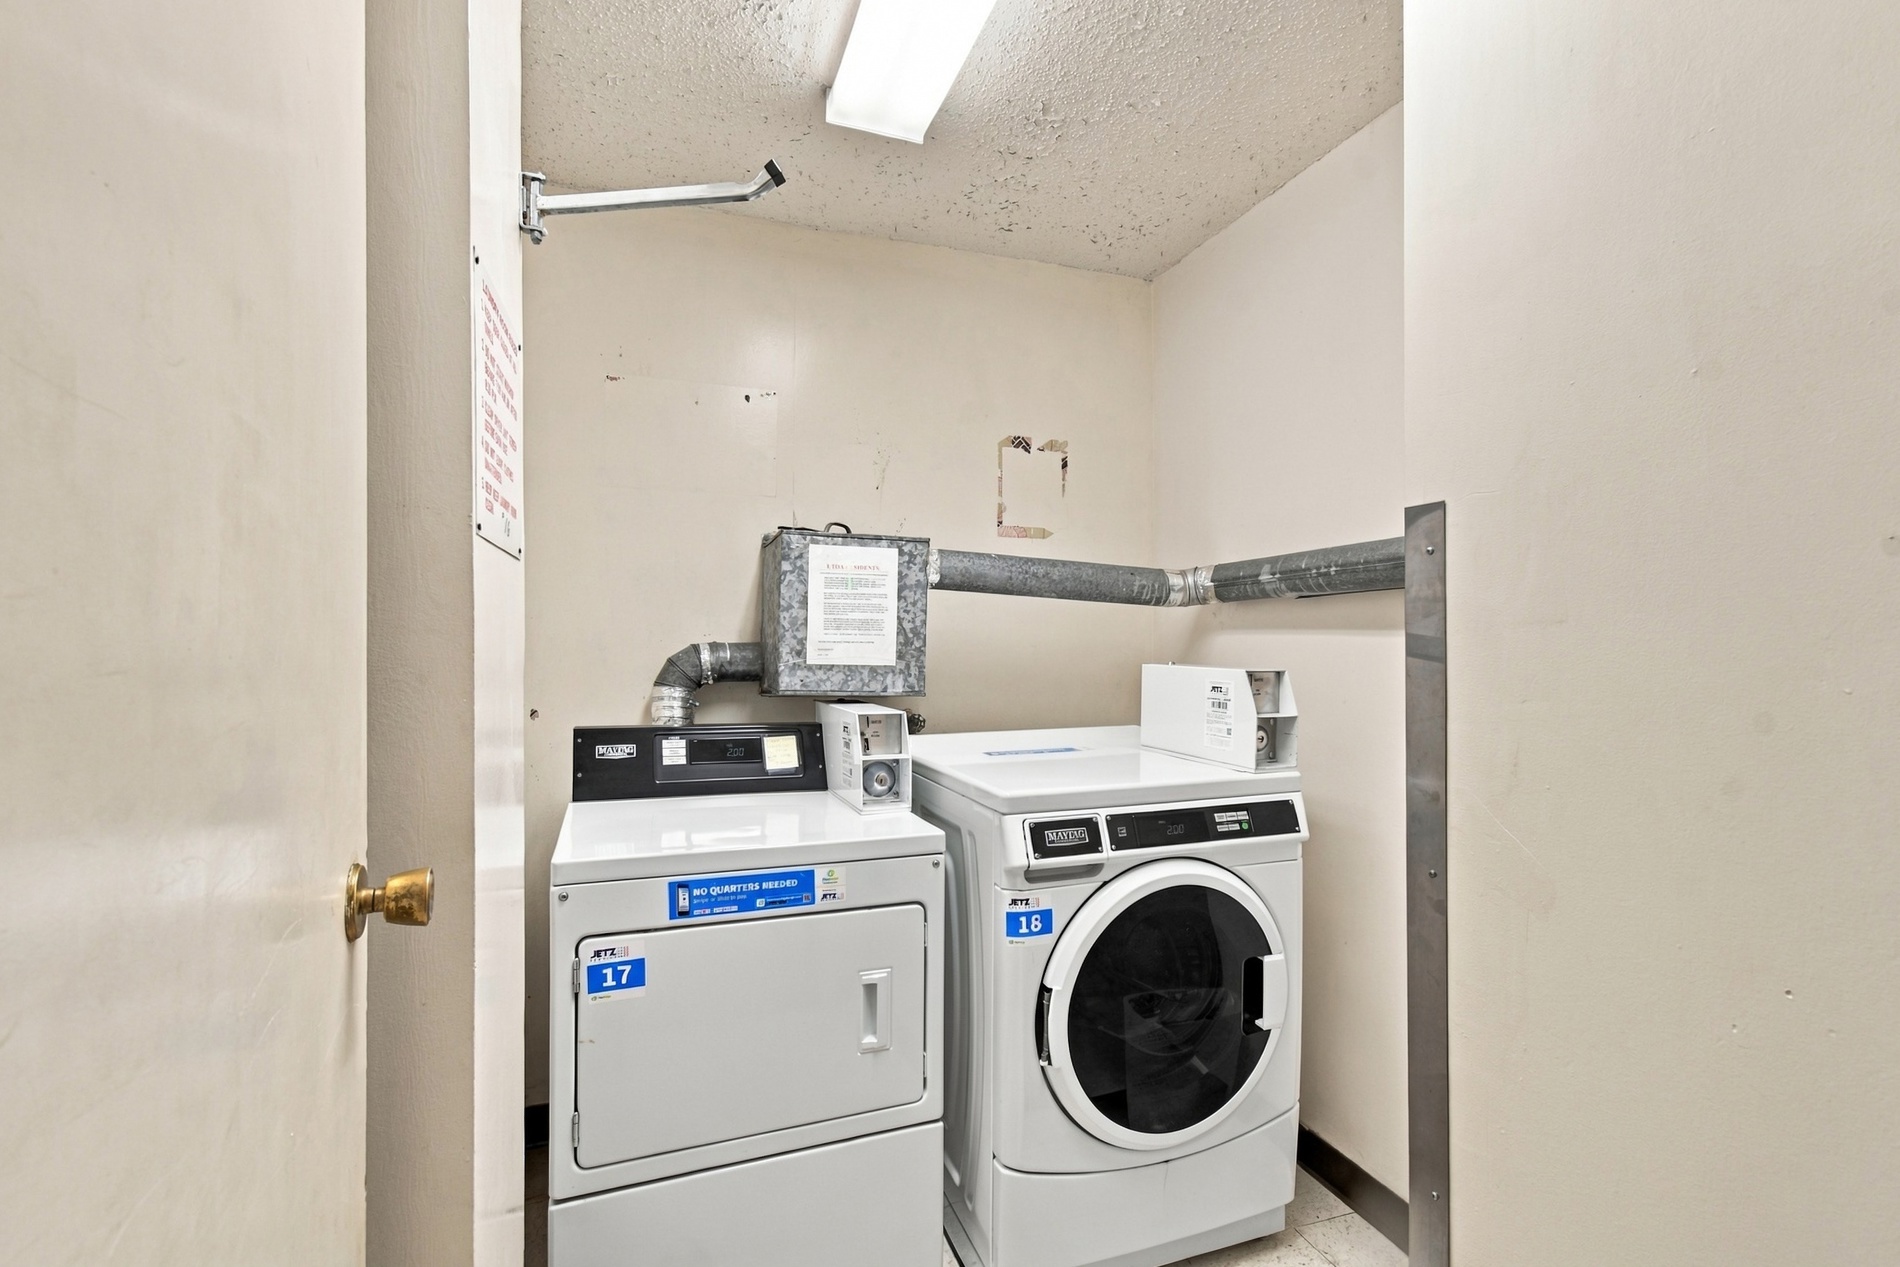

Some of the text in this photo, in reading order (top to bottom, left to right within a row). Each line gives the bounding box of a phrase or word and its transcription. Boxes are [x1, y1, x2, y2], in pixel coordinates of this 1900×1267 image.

[598, 746, 634, 755] MAYTAG
[1047, 829, 1085, 842] MAYTAG
[693, 879, 798, 897] NO QUARTERS NEEDED
[1008, 898, 1030, 906] JETZ
[1018, 914, 1042, 934] 18
[590, 948, 616, 959] JETZ
[602, 965, 632, 987] 17
